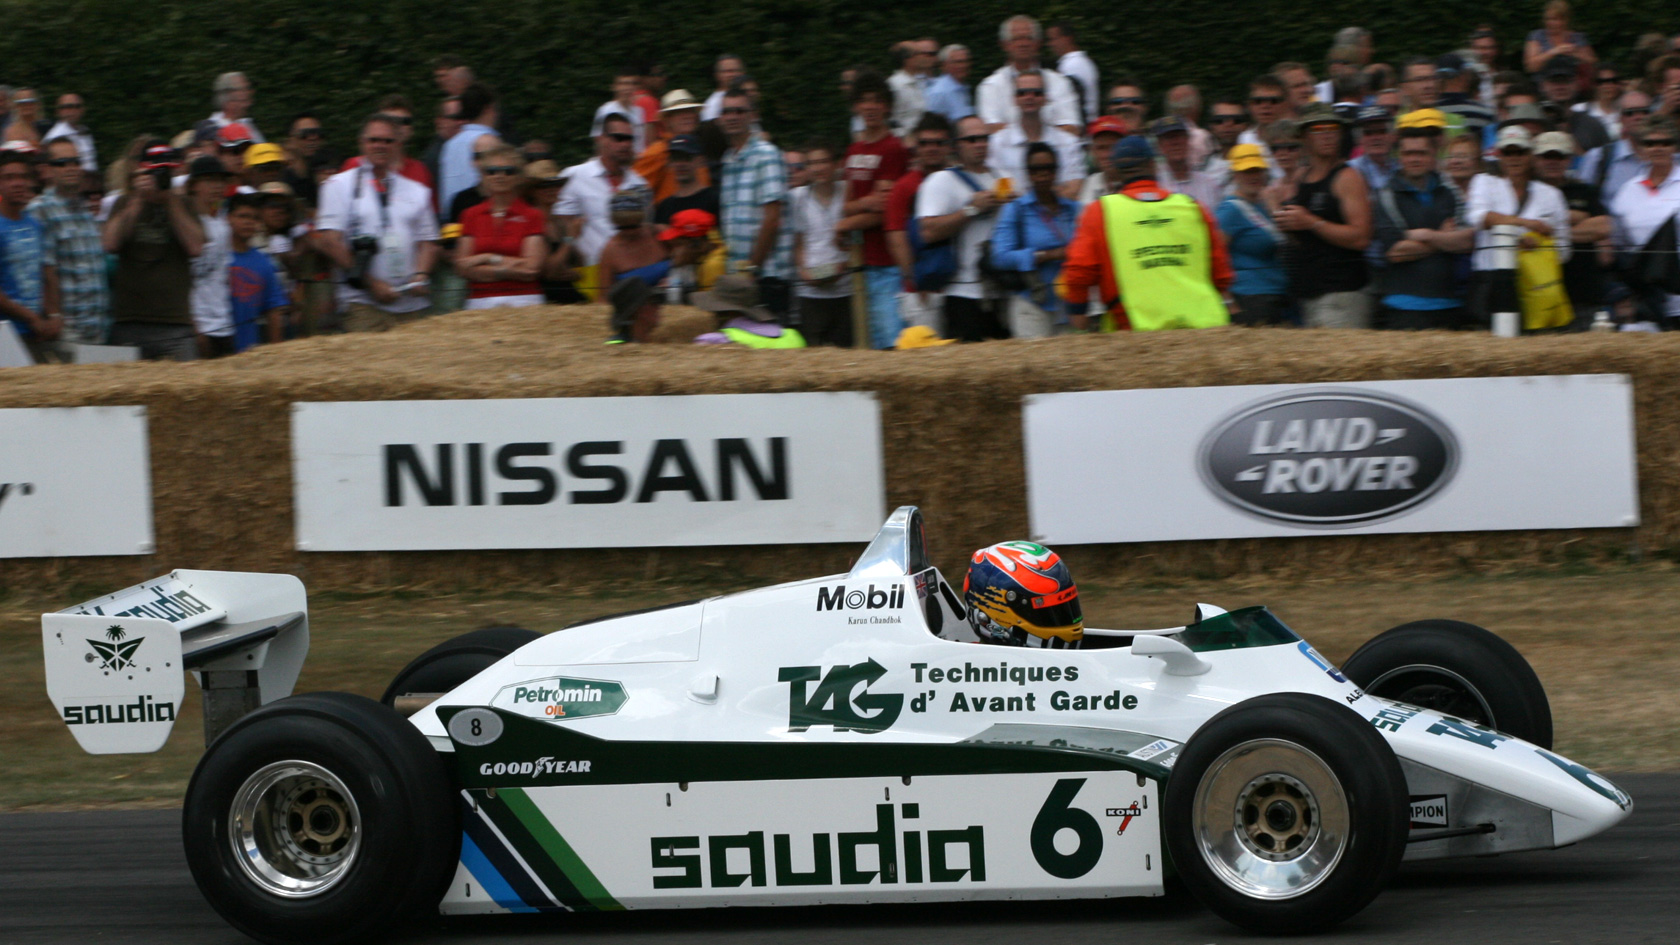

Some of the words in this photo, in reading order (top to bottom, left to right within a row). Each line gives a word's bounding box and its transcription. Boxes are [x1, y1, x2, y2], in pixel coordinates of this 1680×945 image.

[1249, 417, 1378, 454] LAND
[384, 436, 791, 507] NISSAN
[1262, 455, 1419, 494] ROVER
[816, 584, 905, 611] Mobil
[848, 617, 868, 625] Karun
[869, 616, 902, 625] Chandhok
[911, 662, 1080, 685] Techniques
[513, 685, 602, 703] Petromin
[778, 656, 904, 733] TAG
[950, 690, 1036, 712] Avant
[1050, 688, 1138, 712] Garde
[64, 695, 175, 725] saudia
[545, 705, 565, 716] OIL
[471, 718, 482, 736] 8
[480, 757, 591, 778] GOODYEAR
[1107, 808, 1140, 816] KONI
[1030, 778, 1103, 879] 6
[650, 803, 986, 889] saudia
